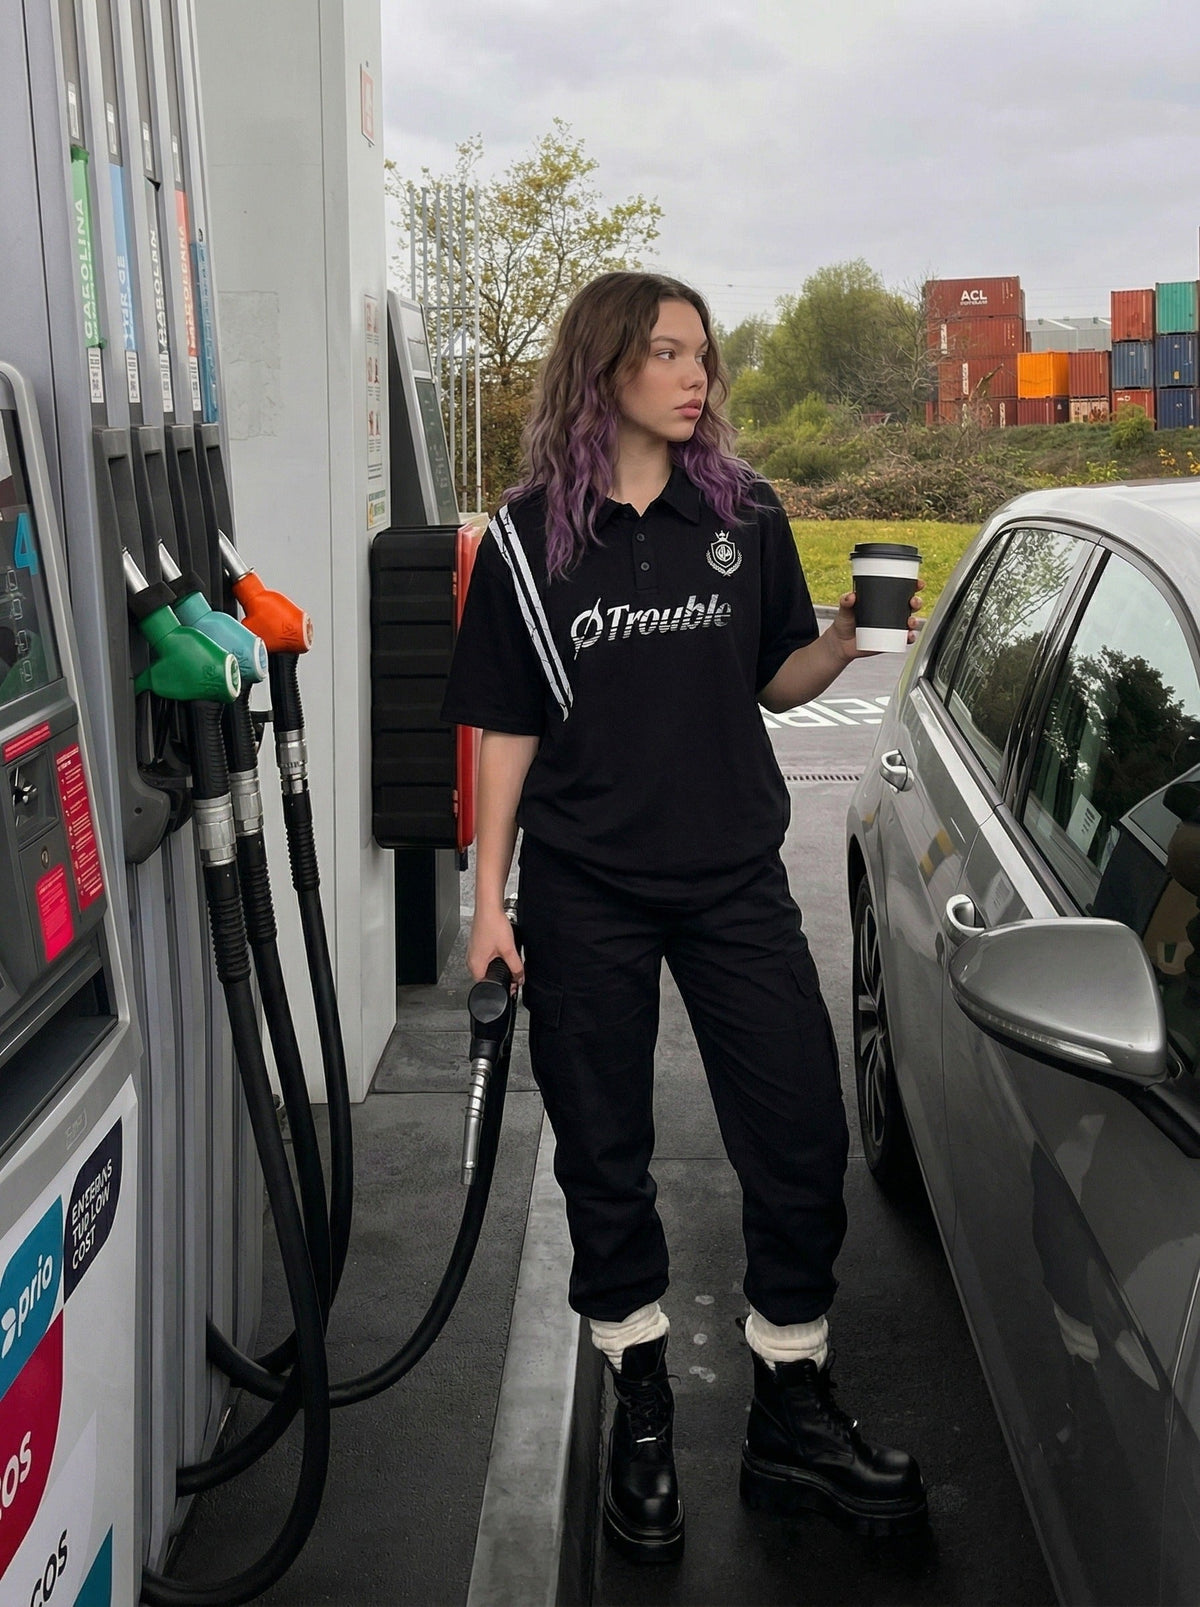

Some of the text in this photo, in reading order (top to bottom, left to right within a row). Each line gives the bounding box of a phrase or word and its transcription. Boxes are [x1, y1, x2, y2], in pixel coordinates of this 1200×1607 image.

[961, 290, 988, 301] ACL
[14, 512, 39, 576] 4
[606, 594, 731, 641] Trouble
[90, 1181, 110, 1223] LOW
[72, 1224, 96, 1270] COST
[17, 1253, 53, 1338] prio
[0, 1431, 32, 1521] OS
